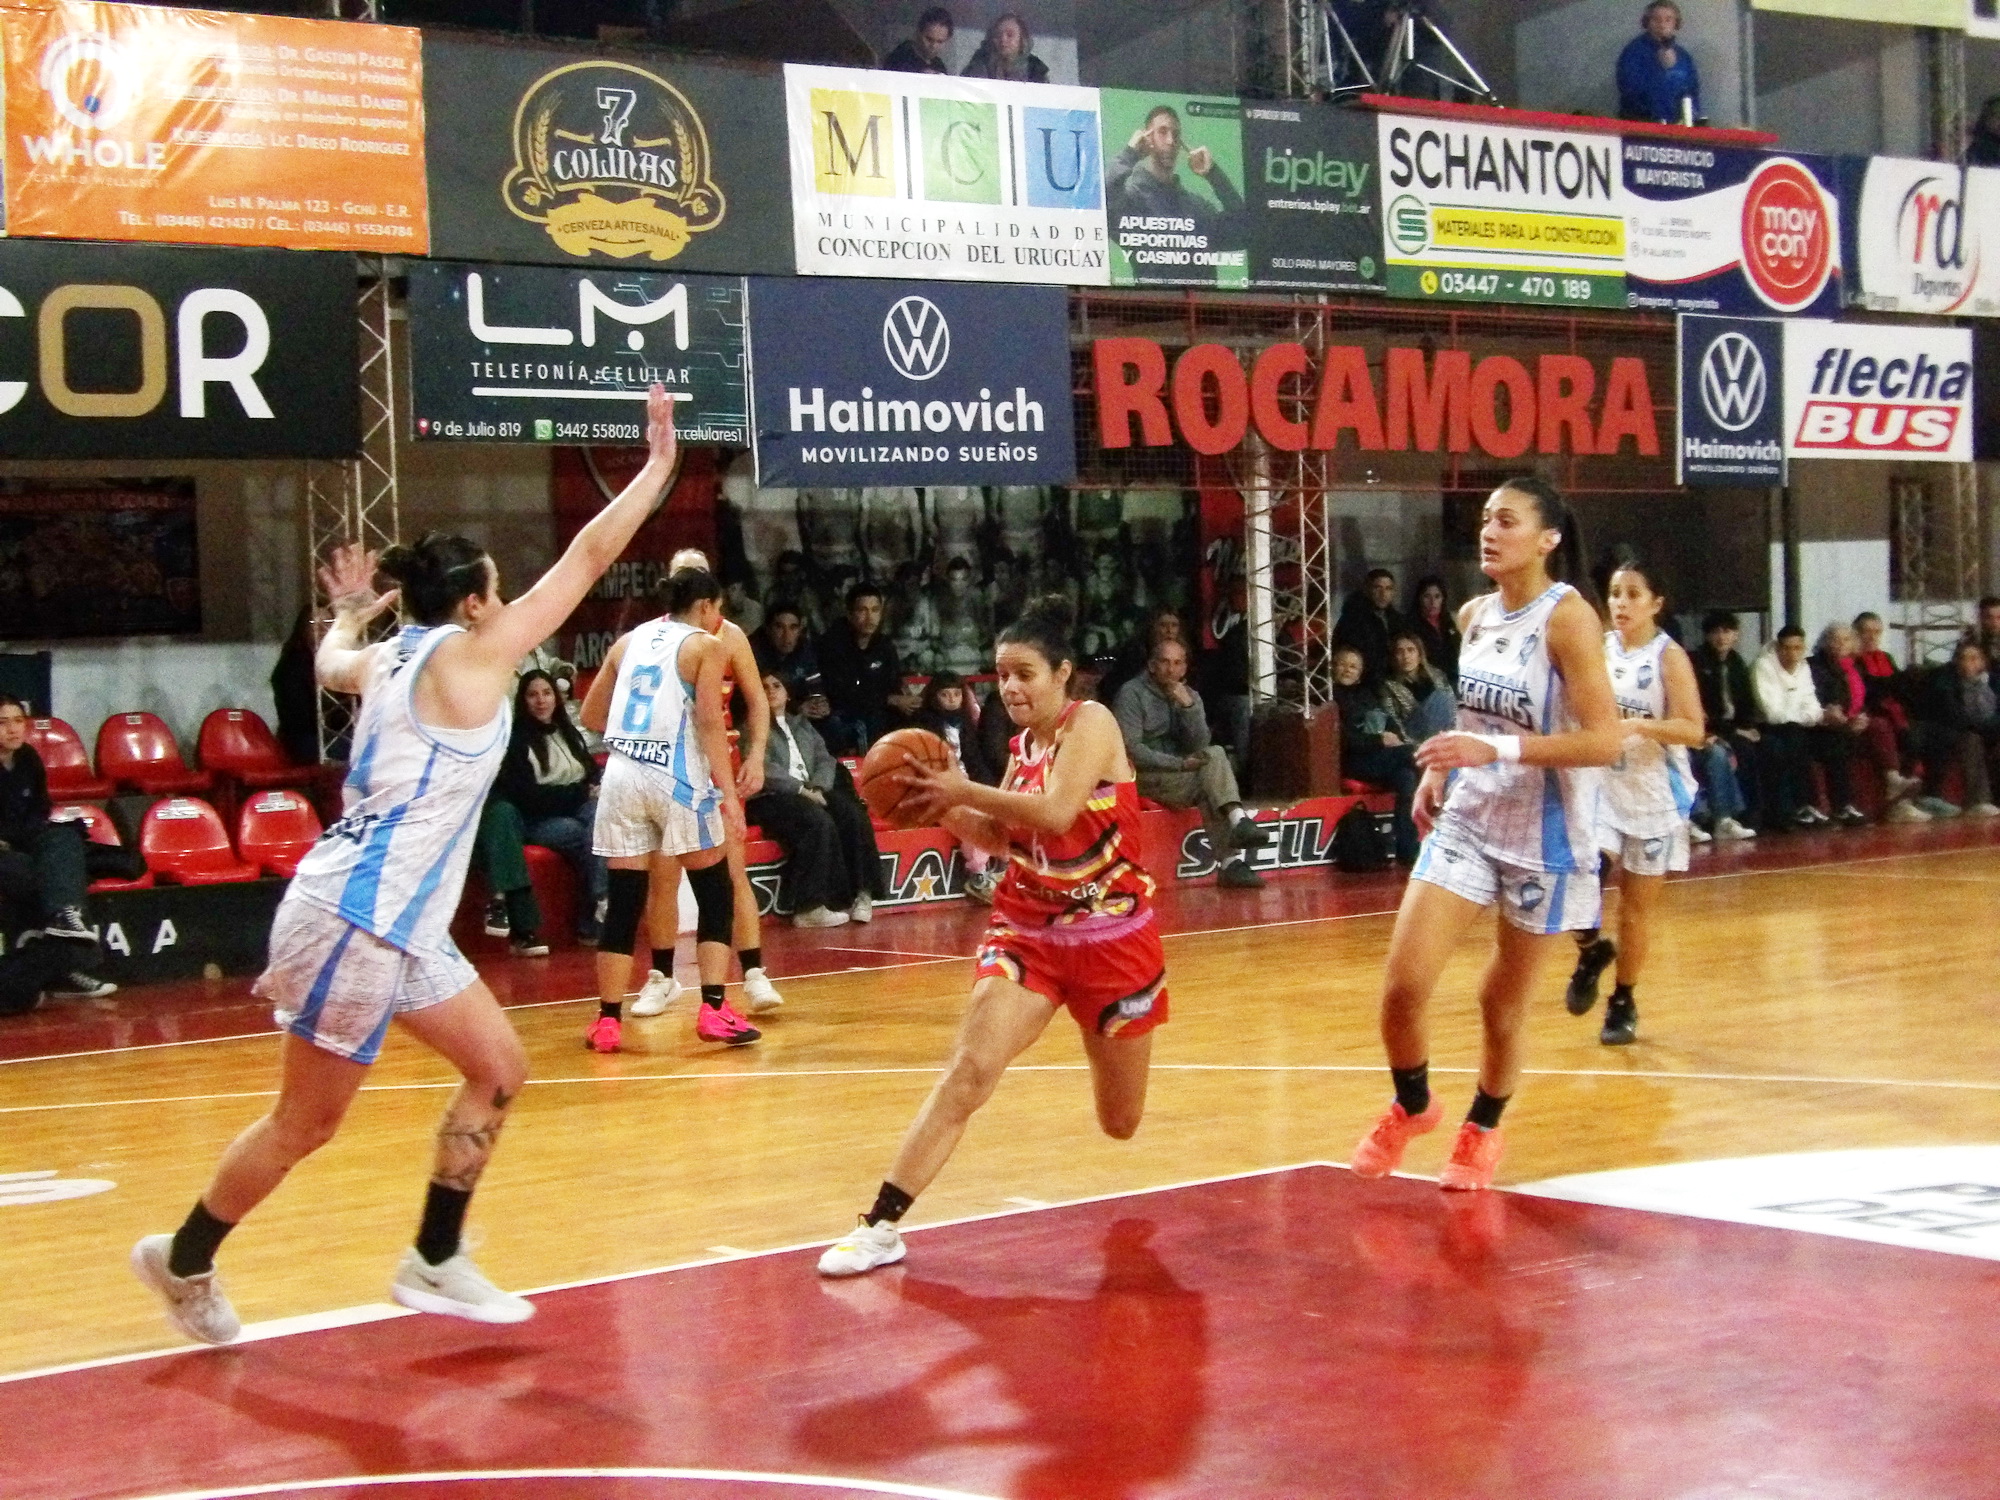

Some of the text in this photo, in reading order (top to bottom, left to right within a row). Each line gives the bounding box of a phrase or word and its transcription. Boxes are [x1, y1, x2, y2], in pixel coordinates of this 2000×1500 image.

[359, 52, 406, 70] PASCAL
[596, 86, 637, 147] 7
[22, 134, 167, 170] WHOLE
[297, 134, 337, 150] DIEGO
[821, 110, 1086, 192] M C U
[552, 147, 677, 189] COLINAS
[1389, 127, 1612, 200] SCHANTON
[1625, 147, 1715, 168] AUTOSERVICIO
[1264, 146, 1371, 198] bplay
[1635, 166, 1705, 190] MAYORISTA
[209, 195, 236, 208] LUIS
[257, 196, 300, 211] PALMA
[304, 200, 330, 213] 123
[563, 217, 676, 242] CERVEZA ARTESANAL
[818, 211, 1104, 242] MUNICIPALIDAD DE
[1119, 215, 1195, 232] APUESTAS
[1436, 219, 1618, 246] MATERIALES PARA LA CONSTRUCCION
[1761, 206, 1817, 238] may
[818, 236, 1106, 269] CONCEPCION DEL URUGUAY
[1119, 232, 1209, 250] DEPORTIVAS
[1761, 232, 1808, 258] con
[1122, 249, 1245, 268] Y CASINO ONLINE
[1271, 257, 1358, 272] SOLO PARA MAYORES
[1441, 272, 1499, 294] 03447
[1520, 276, 1555, 298] 470
[1562, 278, 1591, 299] 189
[0, 284, 275, 420] OR
[471, 360, 690, 385] TELEFONÍA CELULAR
[1810, 348, 1972, 401] flecha
[789, 386, 1044, 433] Haimovich
[1092, 336, 1660, 459] ROCAMORA
[433, 420, 521, 438] 9 de Julio 819
[556, 423, 640, 440] 3442 558028
[1800, 404, 1953, 449] BUS
[802, 442, 1038, 463] MOVILIZANDO SUEÑOS
[1686, 437, 1781, 460] Haimovich
[621, 664, 663, 735] 6
